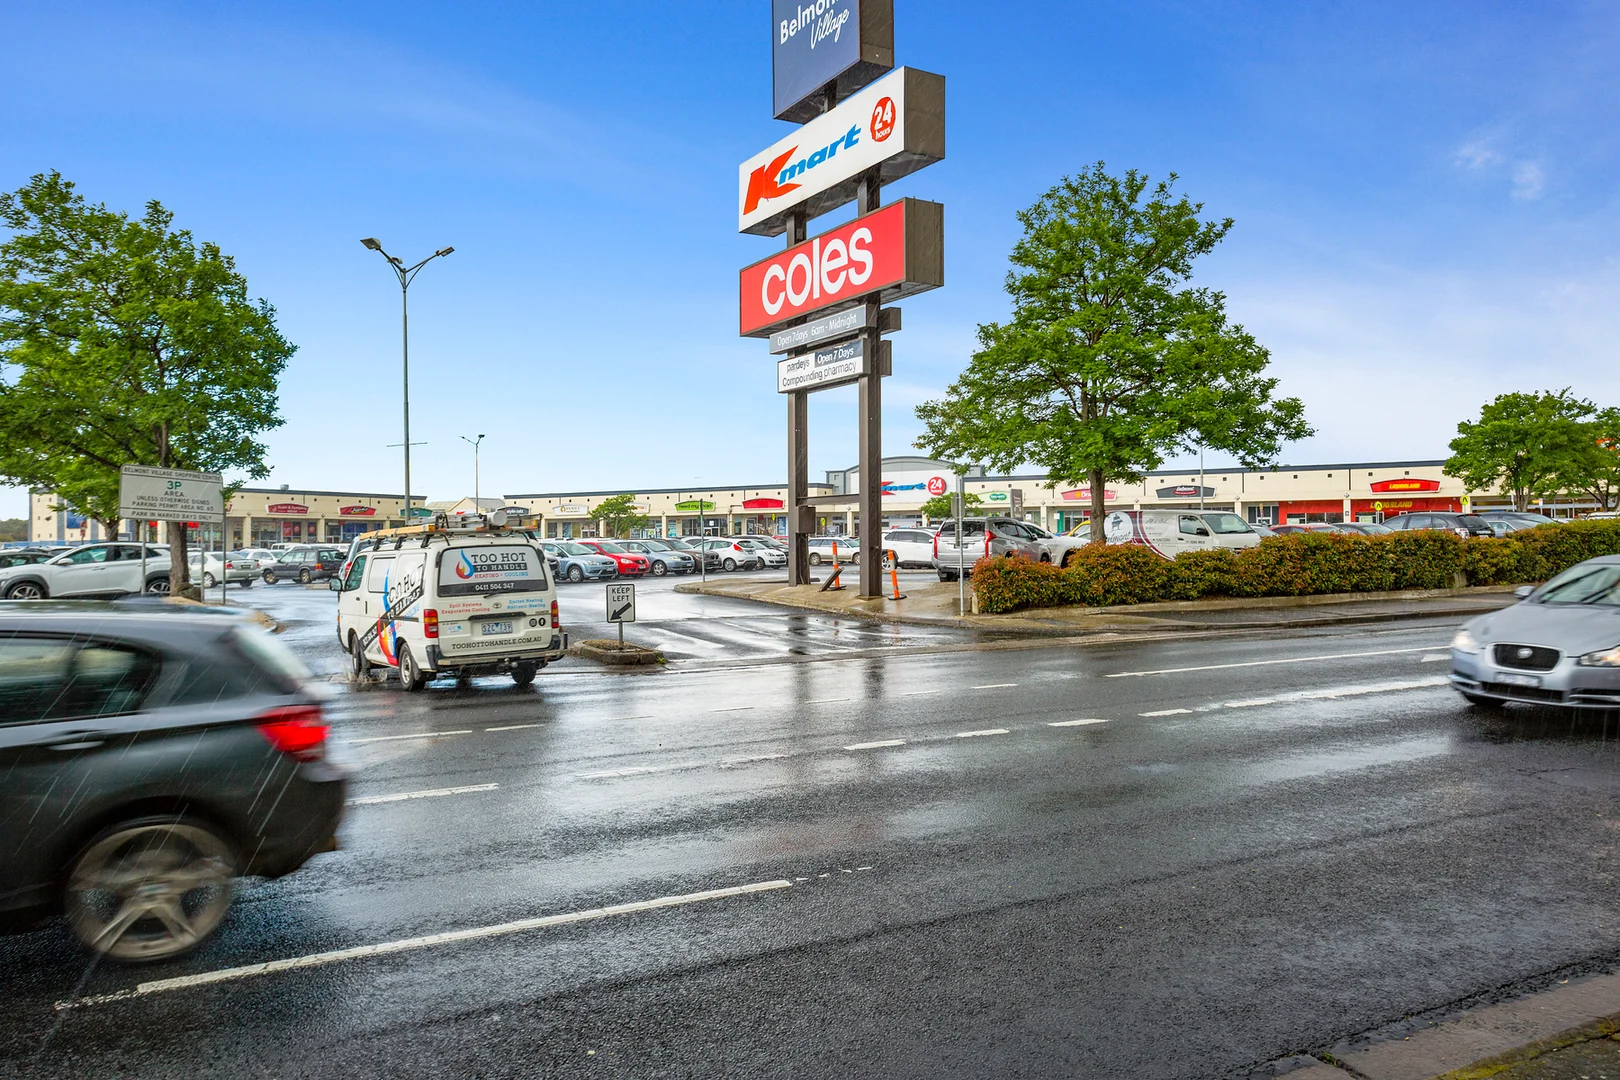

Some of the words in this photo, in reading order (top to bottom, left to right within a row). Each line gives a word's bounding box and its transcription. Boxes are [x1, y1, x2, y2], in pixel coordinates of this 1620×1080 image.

[781, 0, 838, 45] Belmo
[811, 9, 850, 50] Village
[874, 100, 892, 131] 24
[875, 126, 891, 140] hours
[743, 123, 862, 215] Kmart
[762, 227, 874, 315] coles
[777, 335, 791, 348] Open
[811, 325, 825, 336] 6am
[828, 313, 857, 331] Midnight
[817, 354, 832, 365] Open
[838, 347, 854, 359] Days
[782, 370, 823, 387] Compounding
[824, 361, 857, 379] pharmacy
[786, 358, 810, 374] pardeys
[167, 481, 182, 490] 3P
[930, 479, 943, 489] 24
[471, 554, 498, 564] TOO
[500, 552, 526, 562] HOT
[491, 563, 526, 571] HANDLE
[452, 636, 542, 650] TOOHOTTOHANDLE.COM.AU
